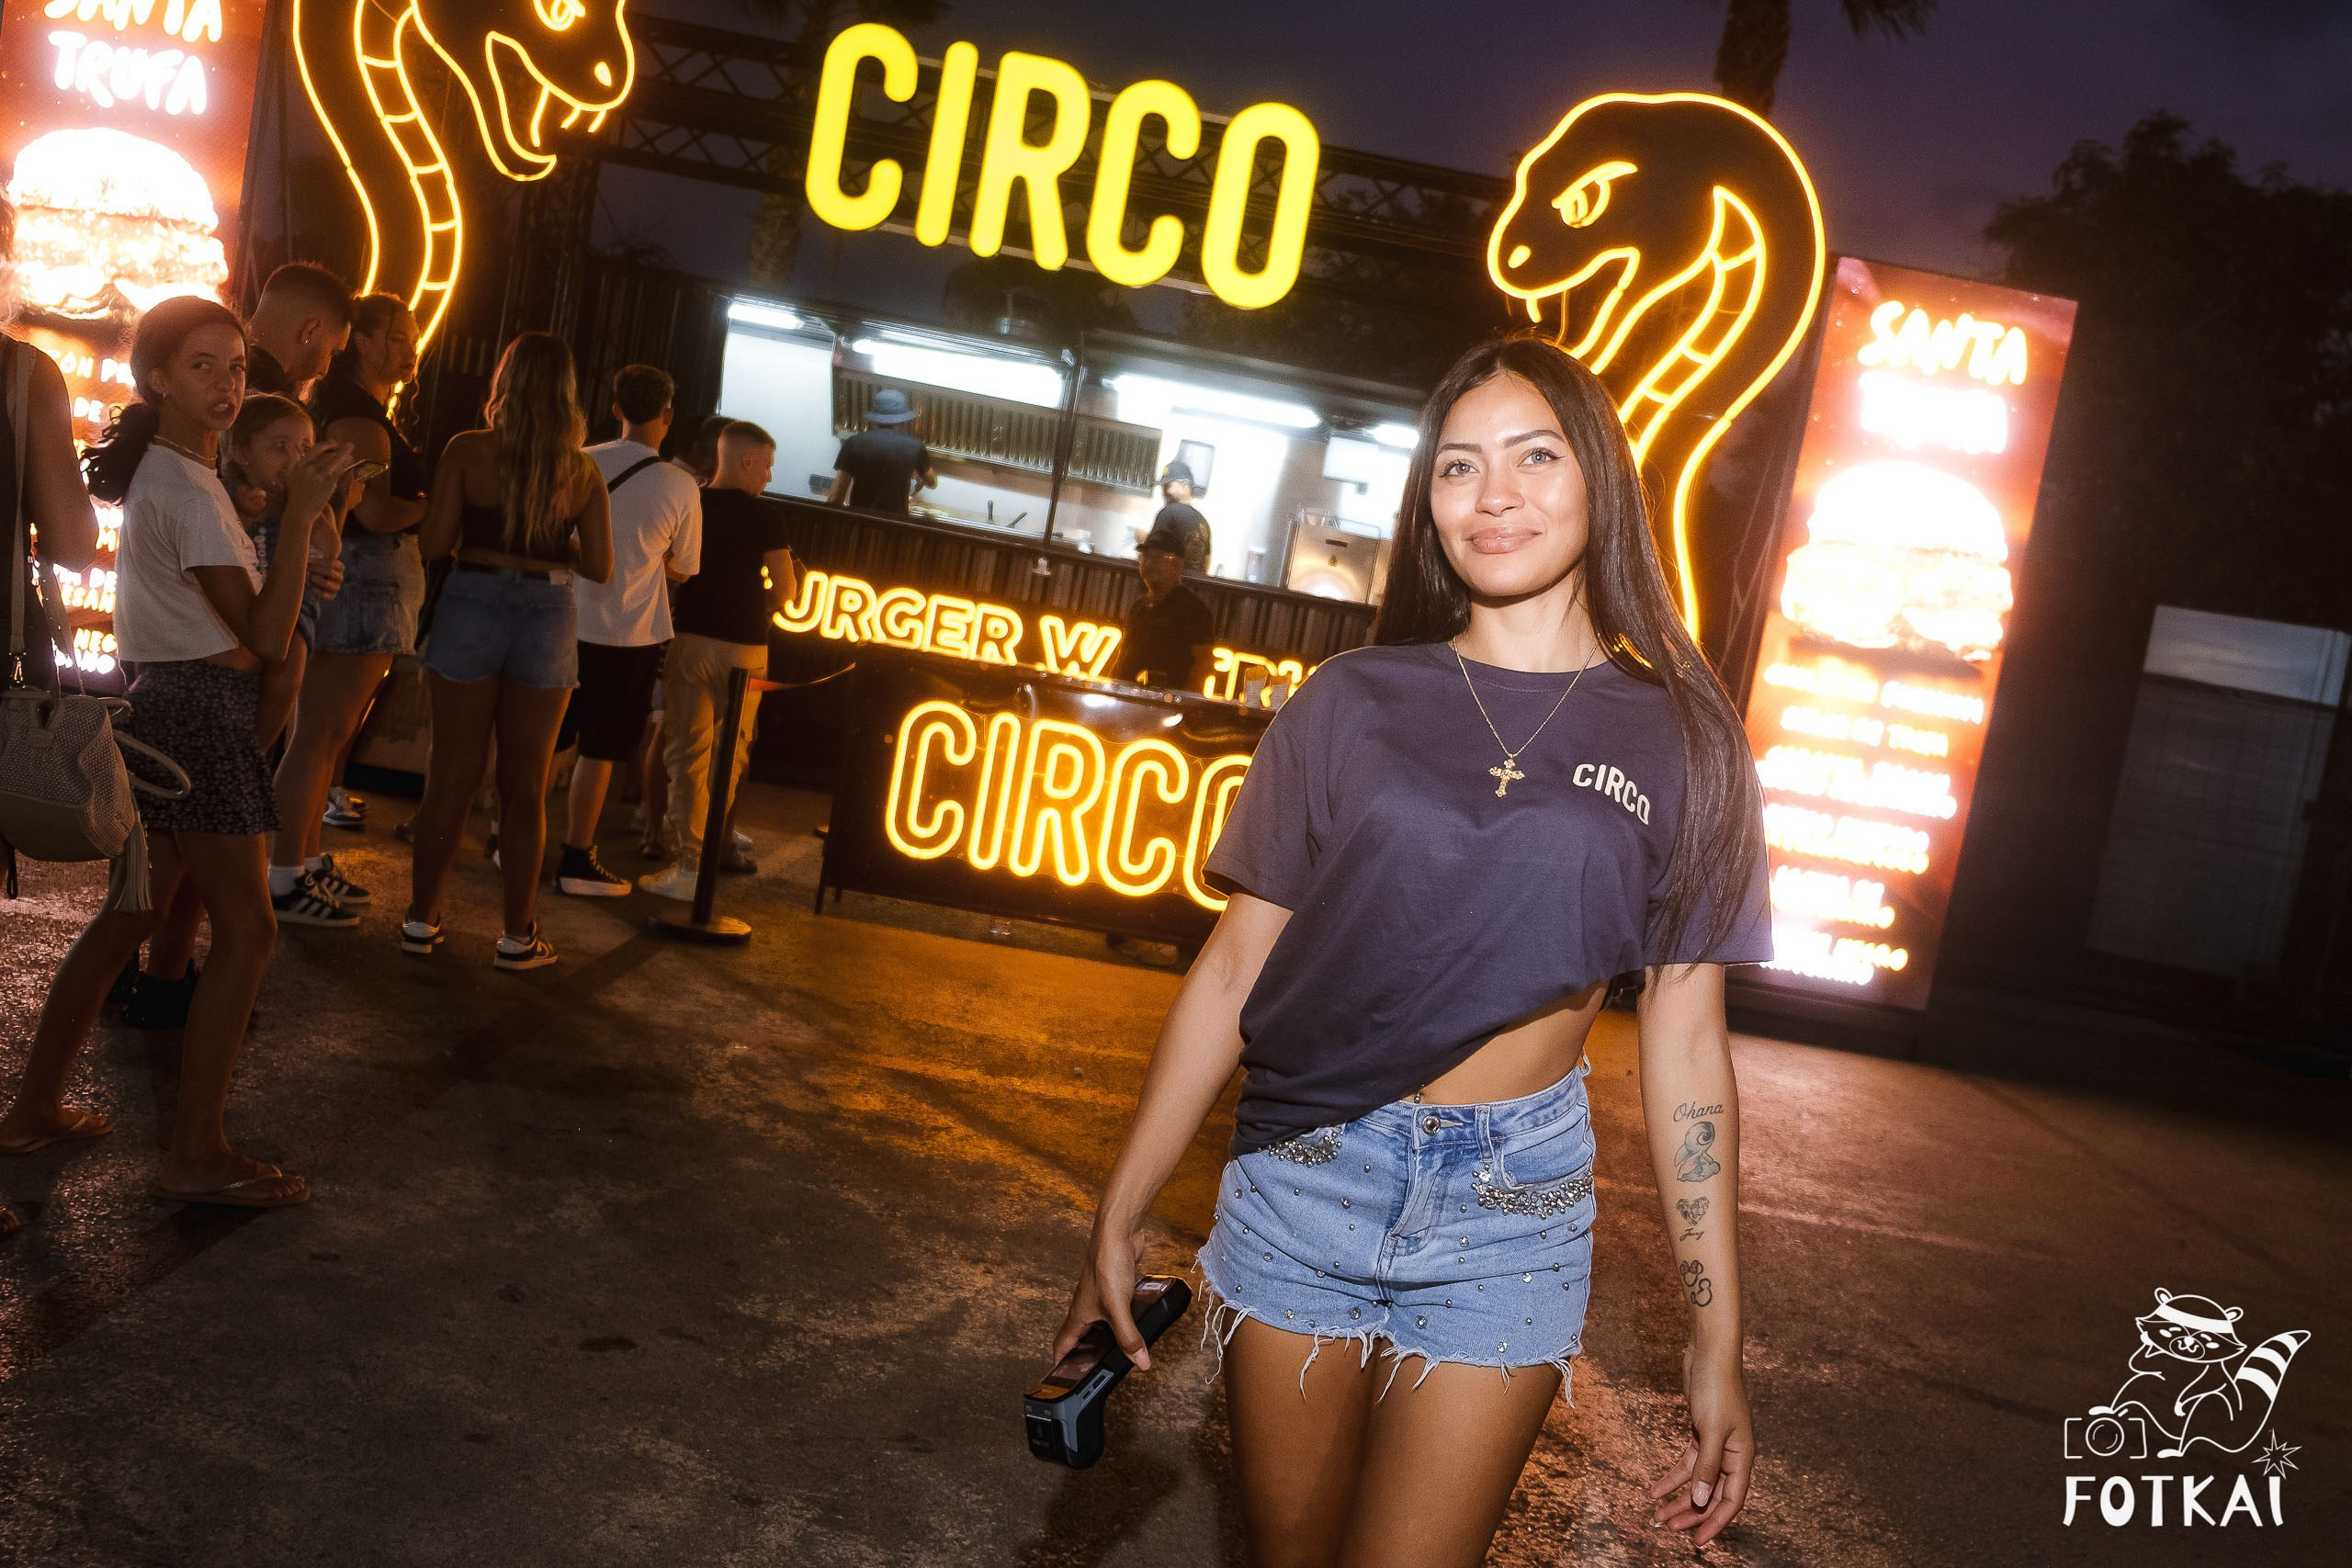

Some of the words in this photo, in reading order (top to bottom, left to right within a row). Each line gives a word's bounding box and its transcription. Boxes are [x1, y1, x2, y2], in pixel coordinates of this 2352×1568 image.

[47, 30, 208, 116] TRUFA
[805, 22, 1320, 310] CIRCO
[1857, 299, 2028, 386] SANTA
[1572, 763, 1651, 826] CIRCO
[1673, 1101, 1724, 1122] Ohana
